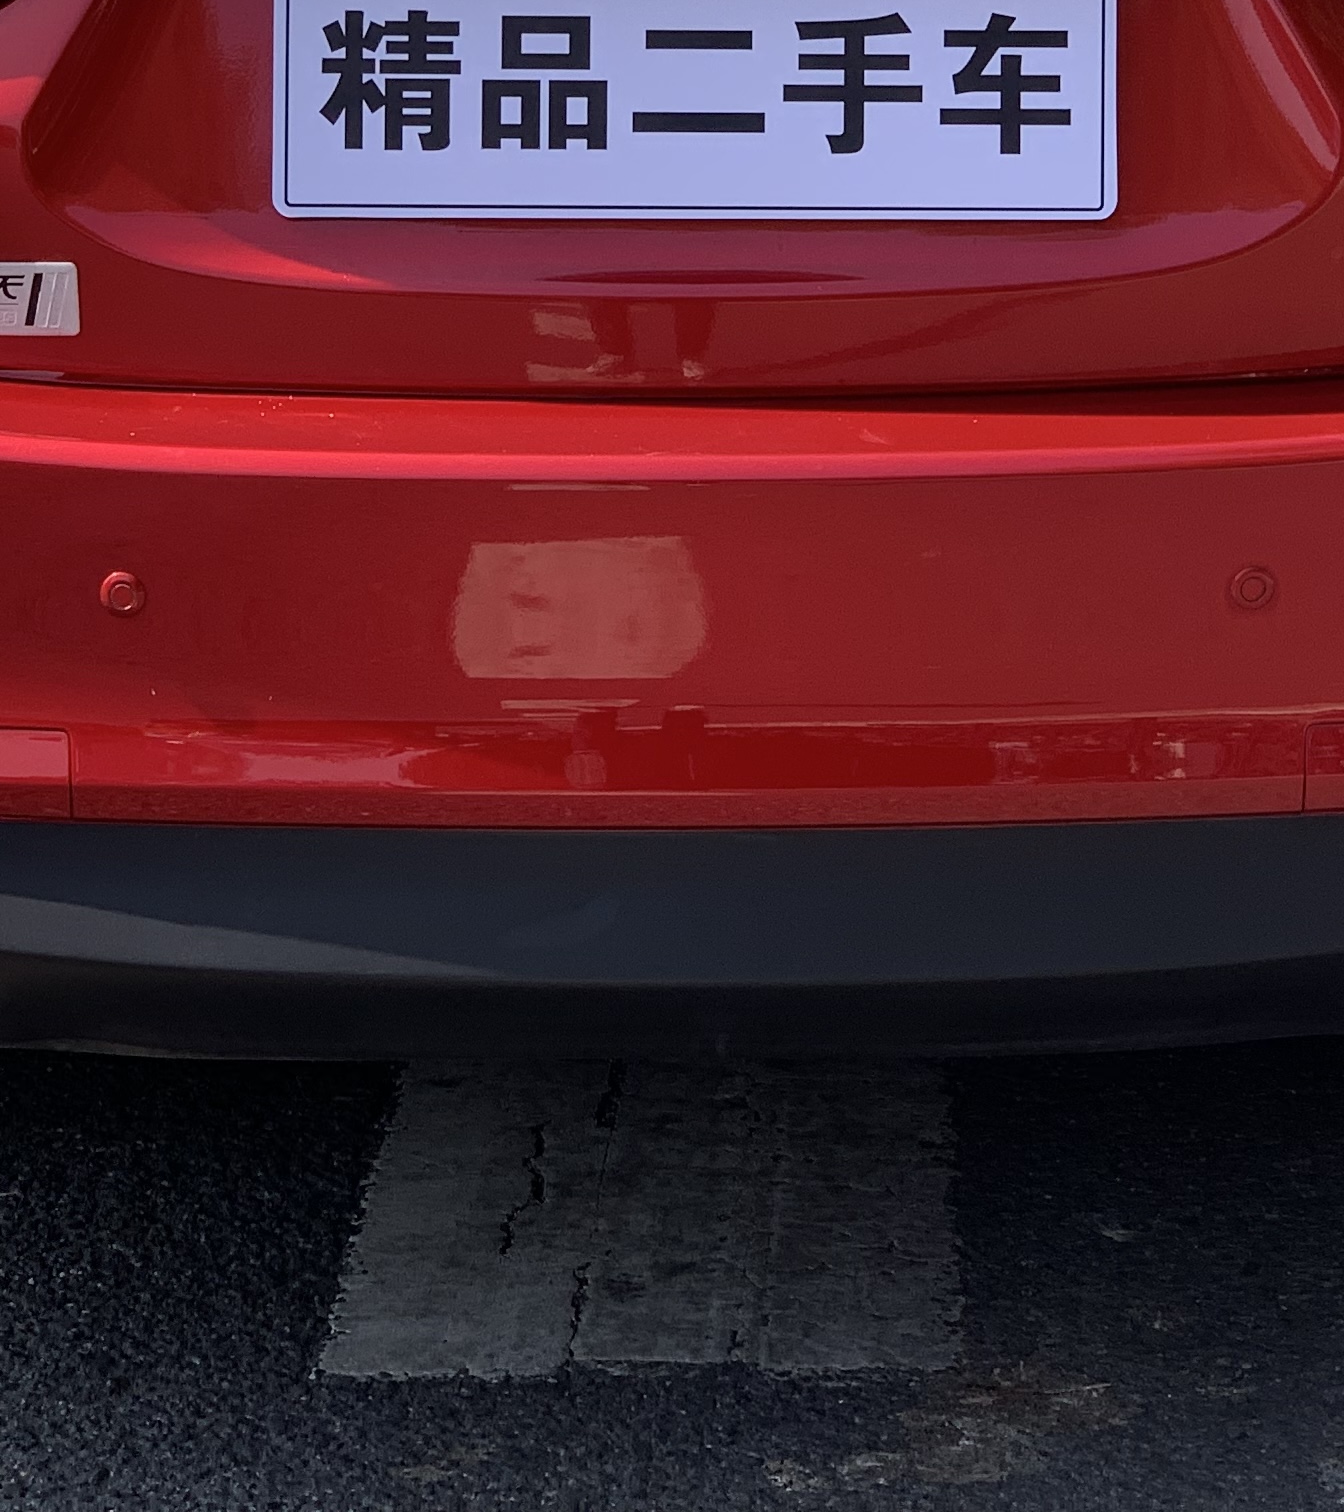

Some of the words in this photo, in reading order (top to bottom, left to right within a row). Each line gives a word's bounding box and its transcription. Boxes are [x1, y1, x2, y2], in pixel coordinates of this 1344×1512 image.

[320, 10, 1072, 154] 精品二手车
